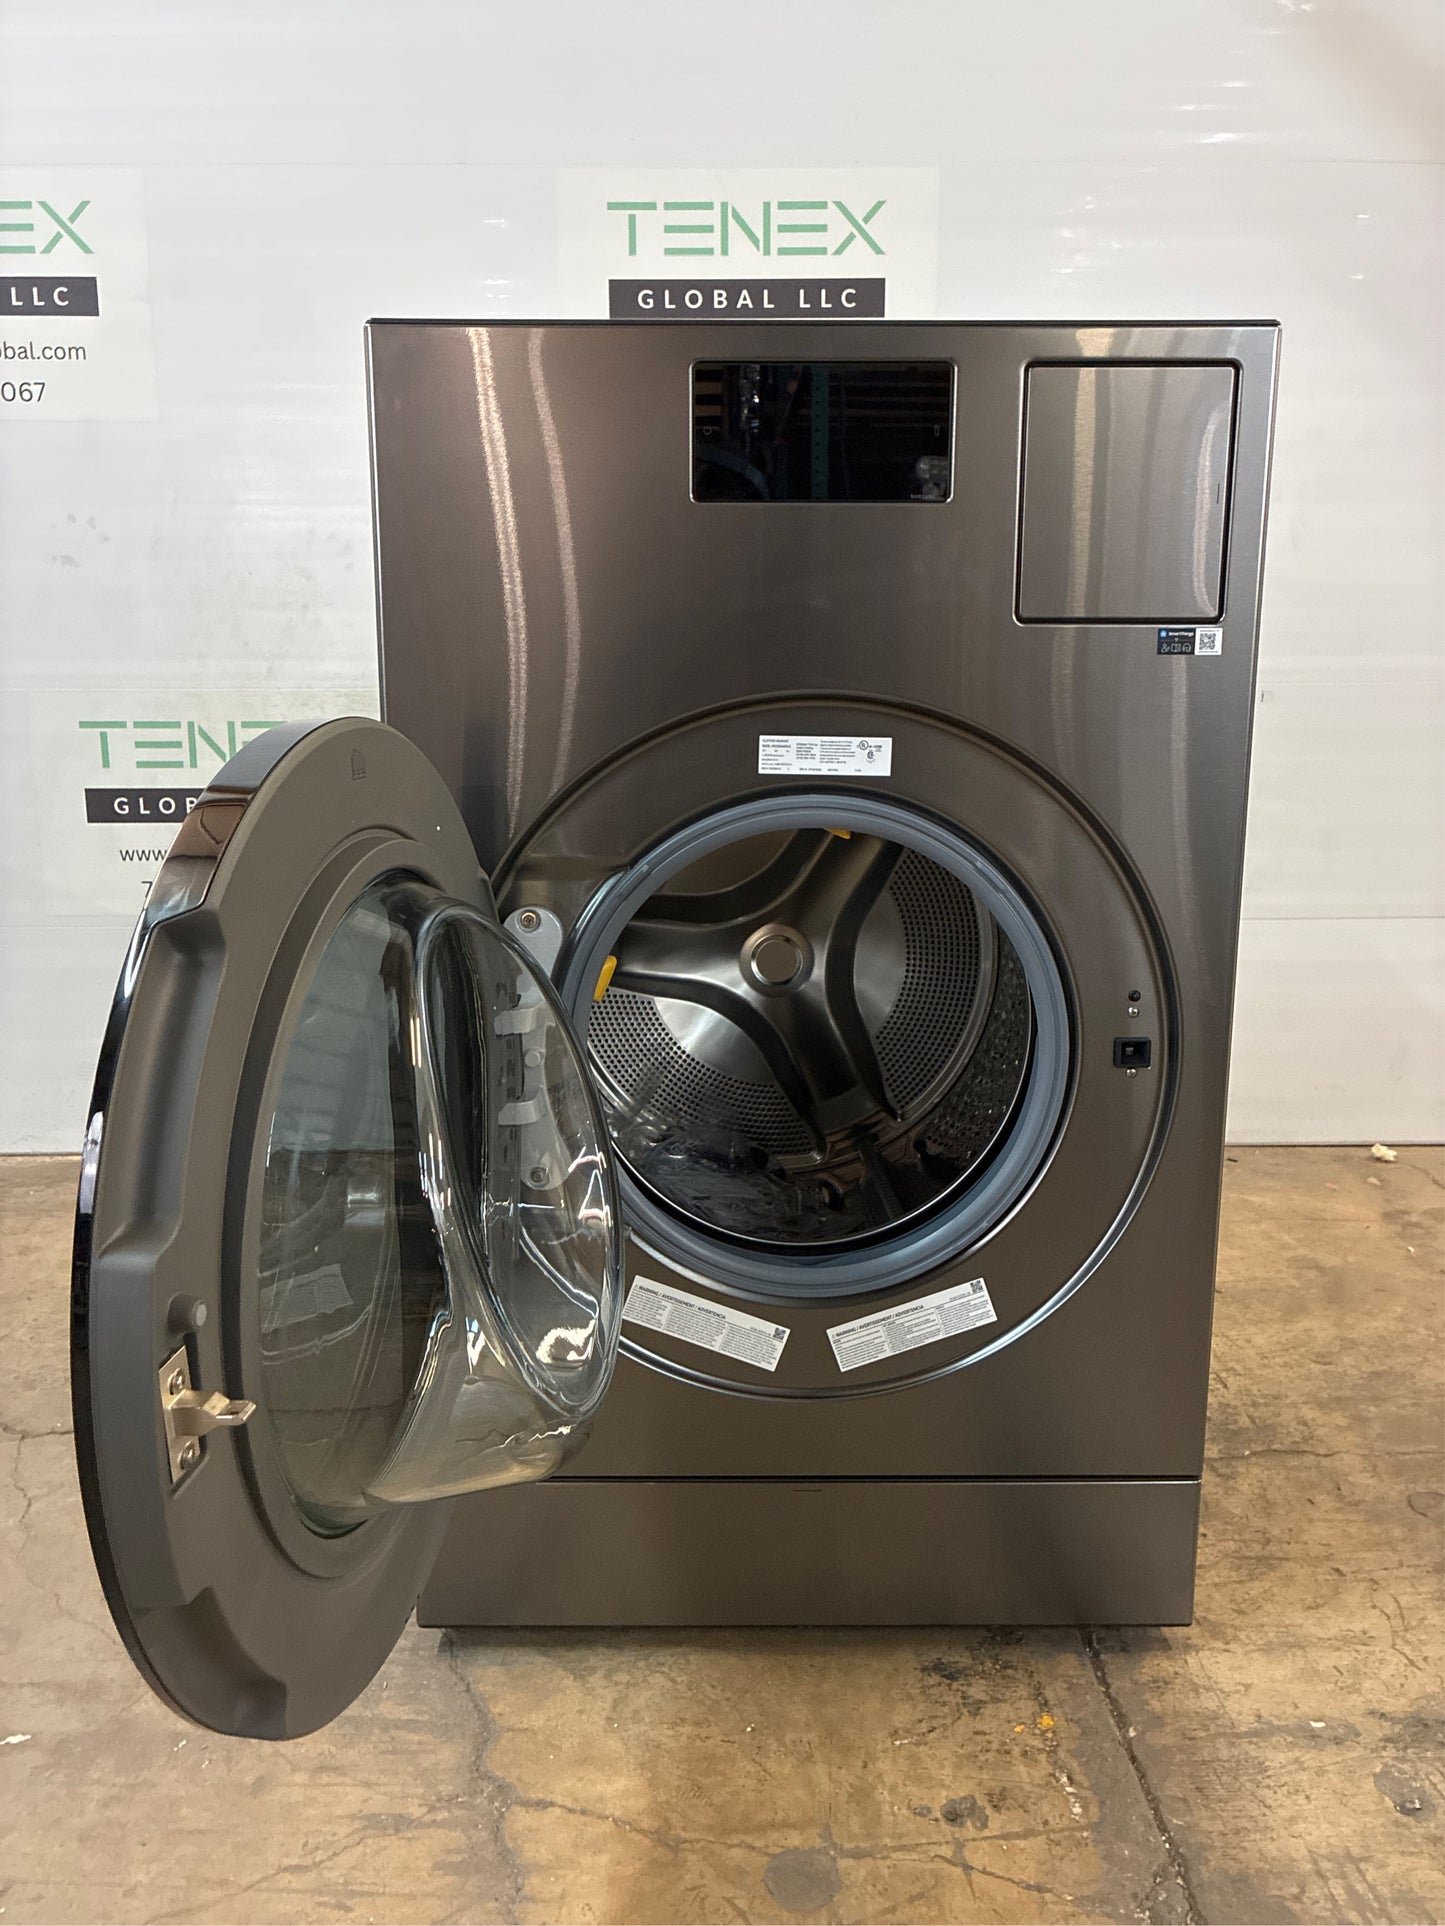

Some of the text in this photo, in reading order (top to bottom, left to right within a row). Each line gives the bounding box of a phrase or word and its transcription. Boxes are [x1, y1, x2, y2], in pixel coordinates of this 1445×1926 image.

[607, 200, 887, 256] TENEX
[10, 286, 69, 306] LLC
[637, 288, 857, 309] GLOBAL LLC
[0, 341, 86, 360] bal.com
[1, 381, 45, 402] 067
